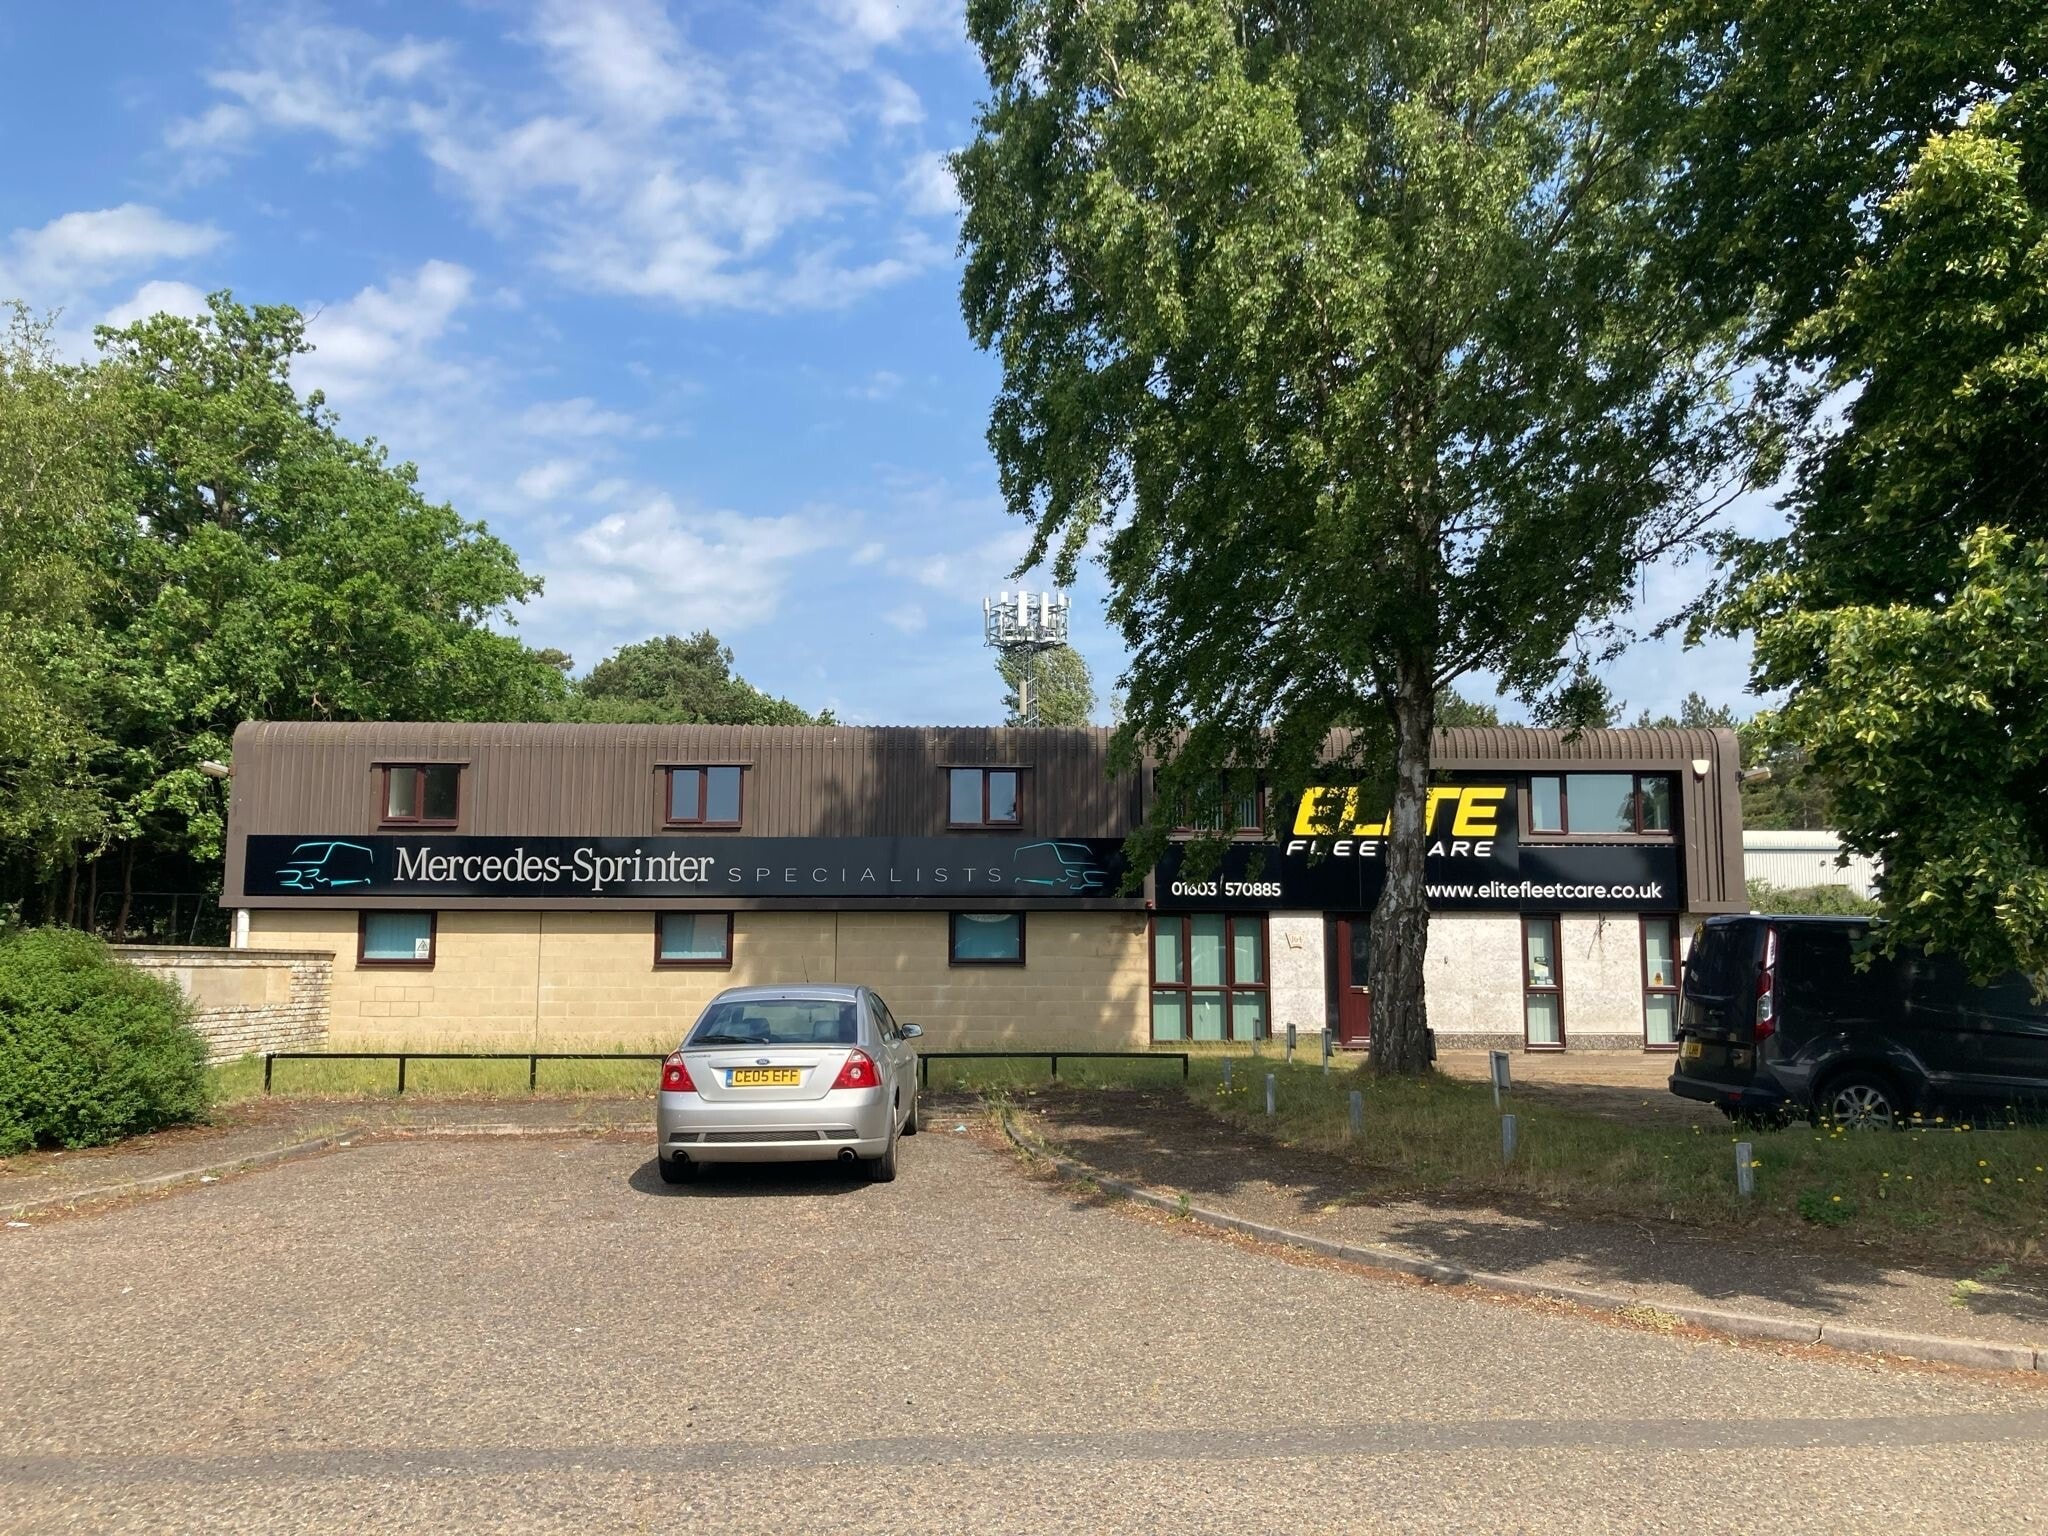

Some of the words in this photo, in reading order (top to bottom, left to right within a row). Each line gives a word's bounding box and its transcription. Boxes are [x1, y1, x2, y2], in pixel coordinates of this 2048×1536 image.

[393, 847, 715, 891] Mercedes-Sprinter
[727, 867, 1002, 883] SPECIALISTS
[1171, 881, 1218, 896] 01603
[1224, 882, 1282, 897] 570885
[1425, 881, 1663, 898] www.elitefleetcare.co.uk
[735, 1069, 769, 1083] CE05
[772, 1068, 799, 1082] EFF
